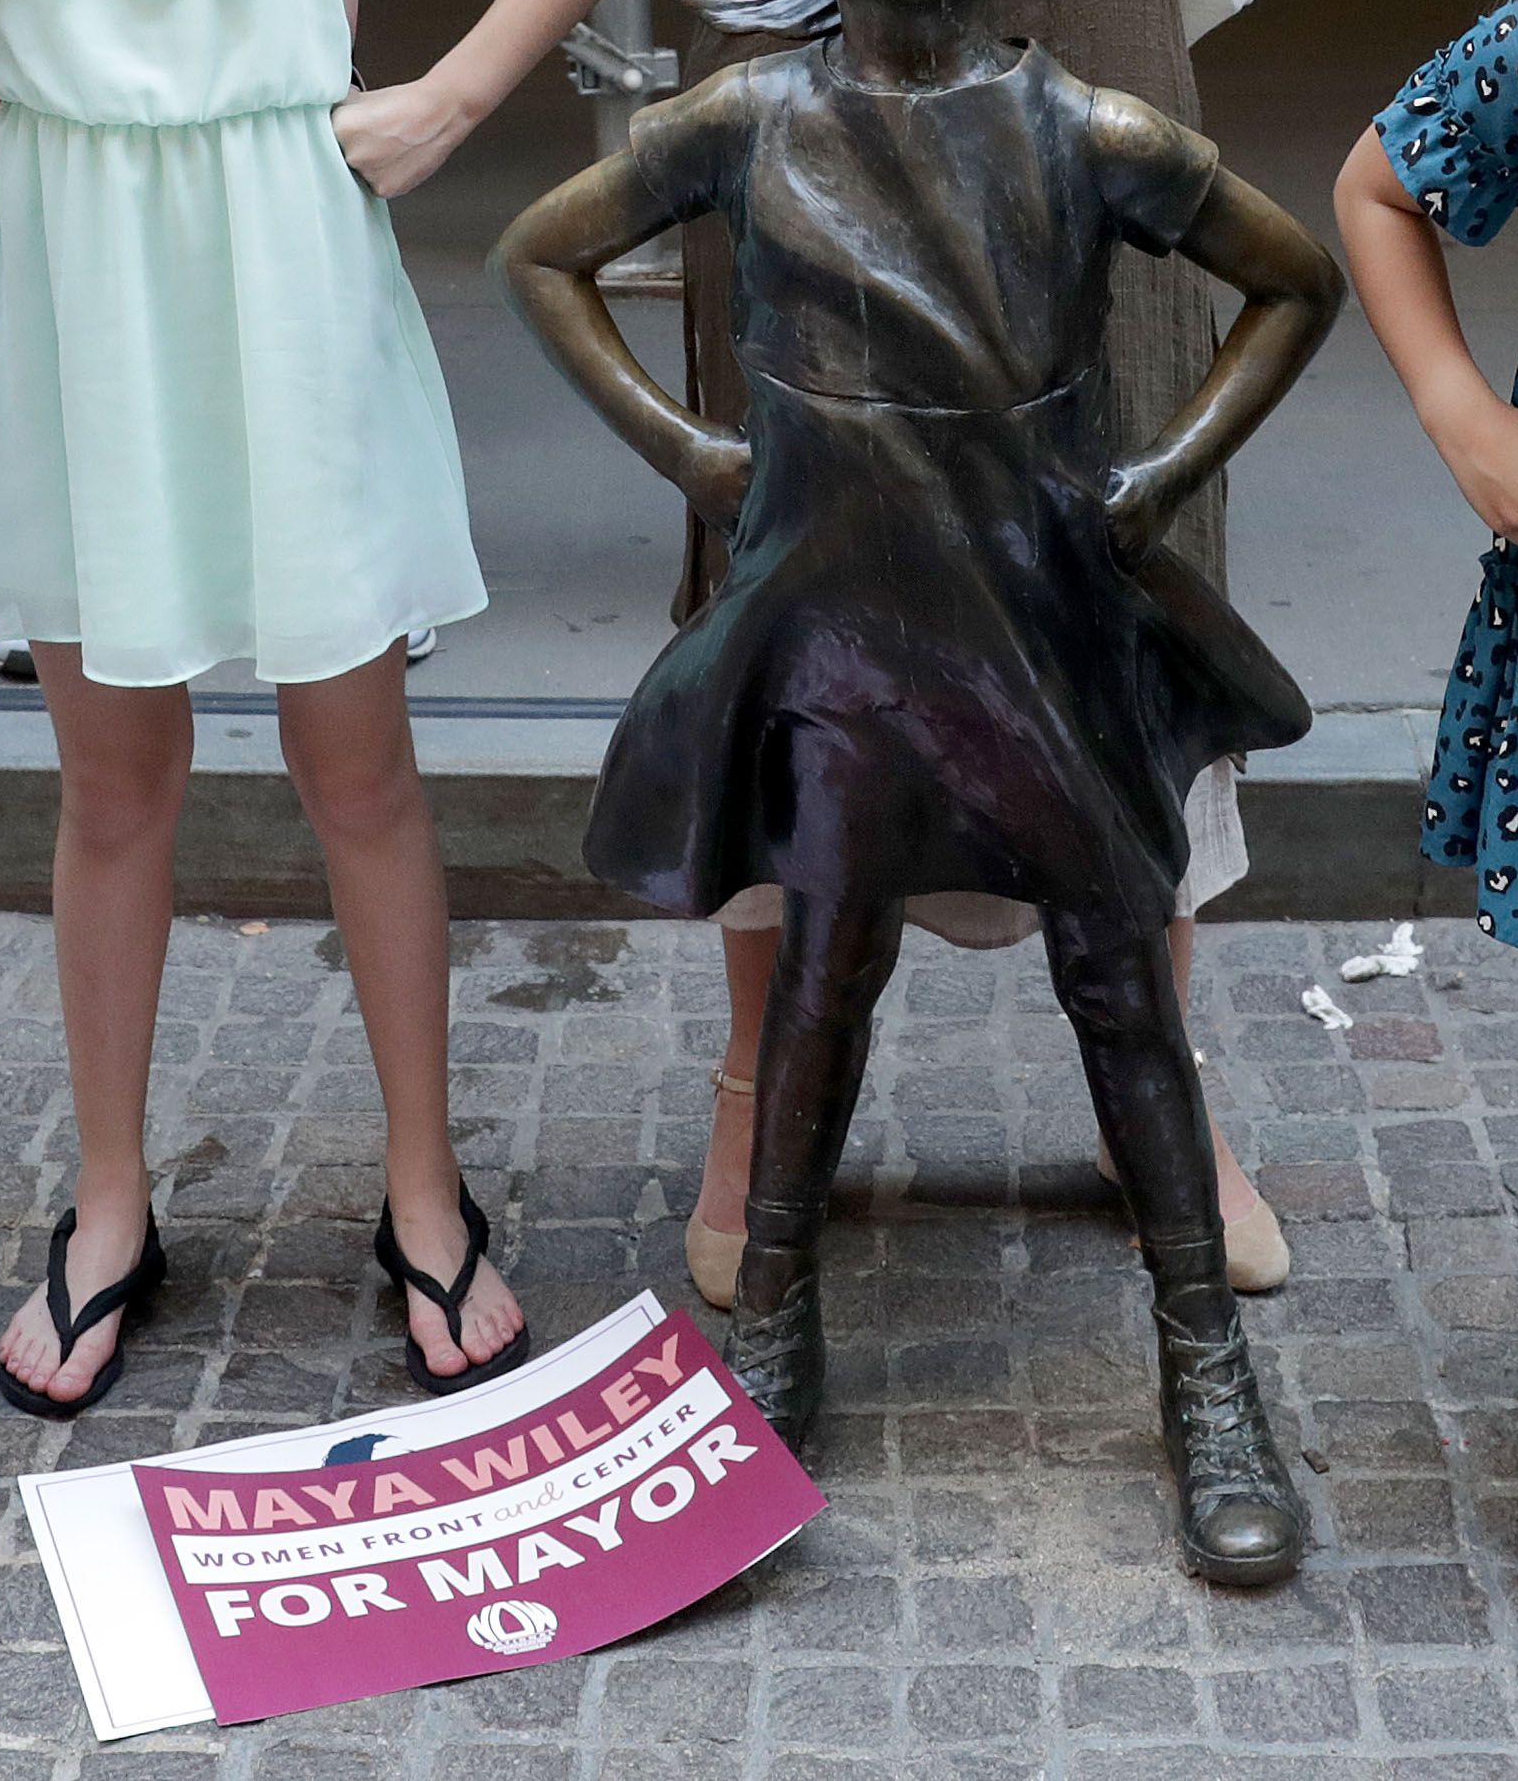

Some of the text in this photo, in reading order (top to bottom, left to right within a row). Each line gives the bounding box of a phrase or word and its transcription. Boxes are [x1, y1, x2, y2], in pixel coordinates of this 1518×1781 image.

[163, 1333, 685, 1530] MAYA WILEY
[193, 1402, 698, 1568] WOMEN FRONT and CENTER
[204, 1423, 758, 1638] FOR MAYOR
